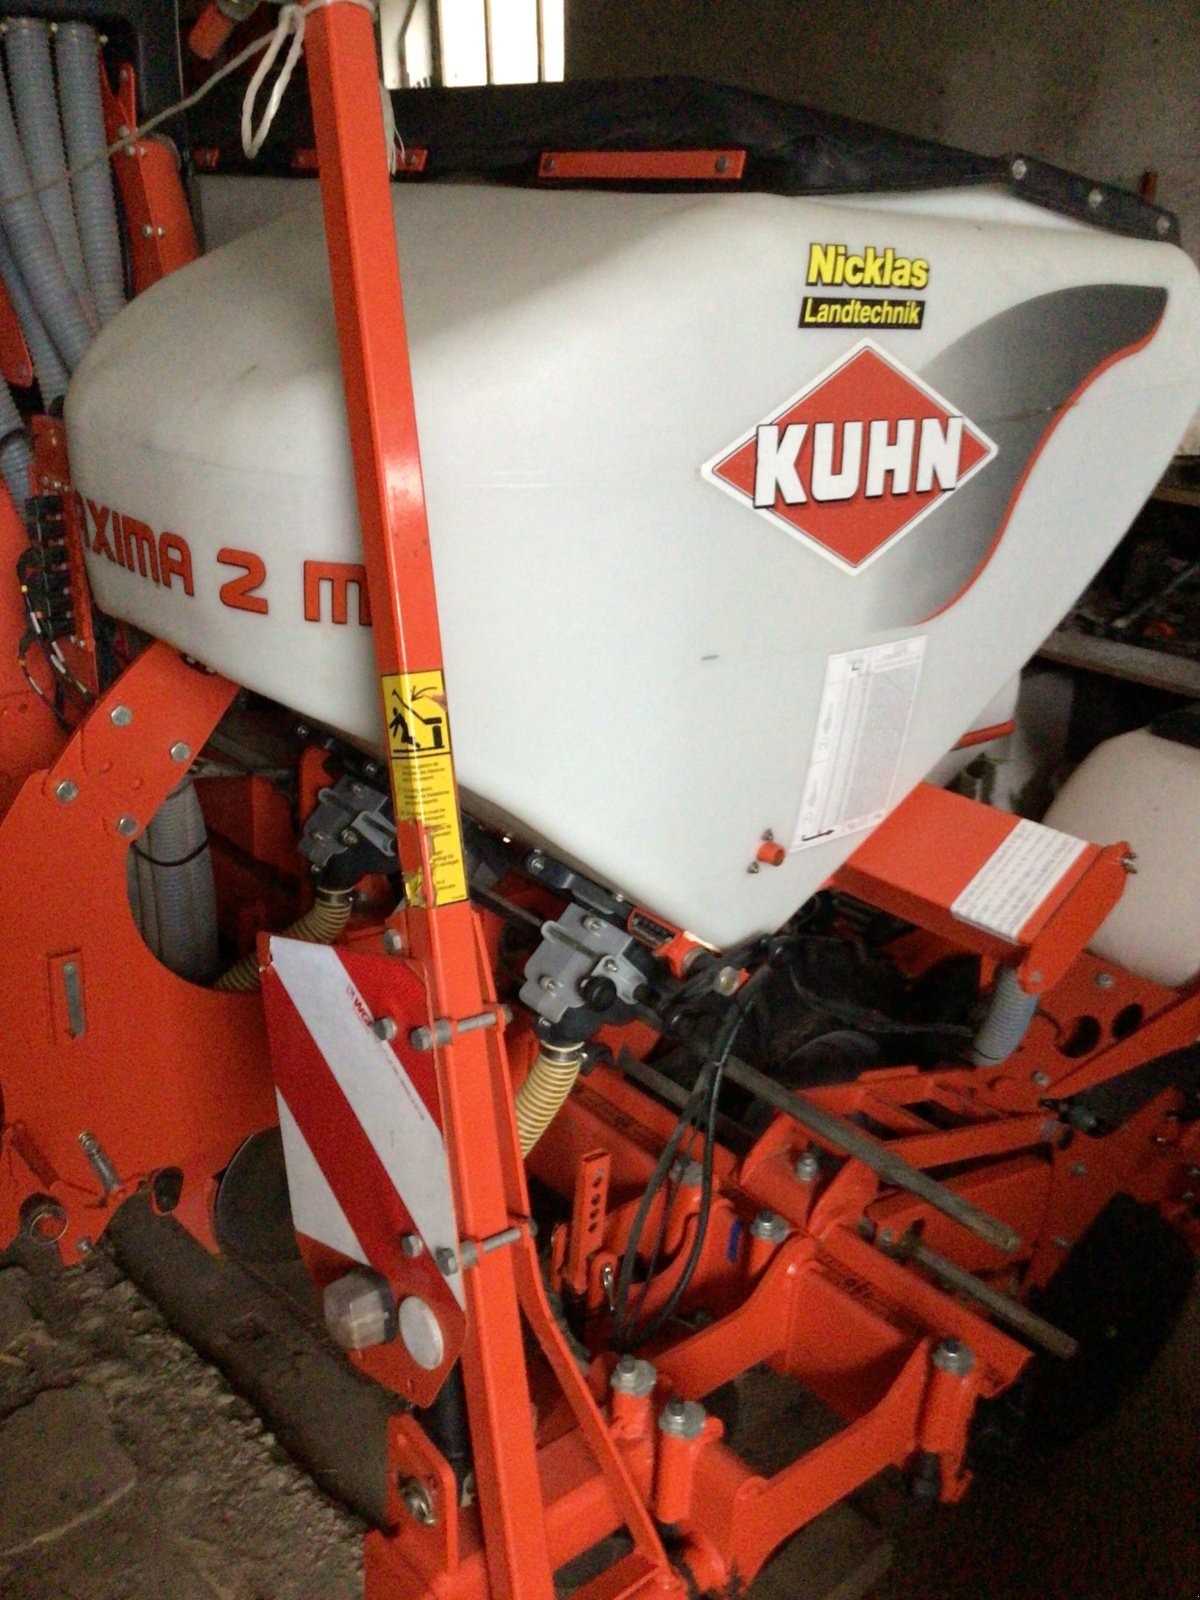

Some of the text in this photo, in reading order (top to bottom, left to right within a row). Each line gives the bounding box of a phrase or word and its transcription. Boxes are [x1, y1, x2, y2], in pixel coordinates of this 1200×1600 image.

[807, 243, 929, 289] Nicklas
[803, 298, 921, 324] Landtechnik
[754, 416, 963, 508] KUHN
[217, 547, 268, 615] 2
